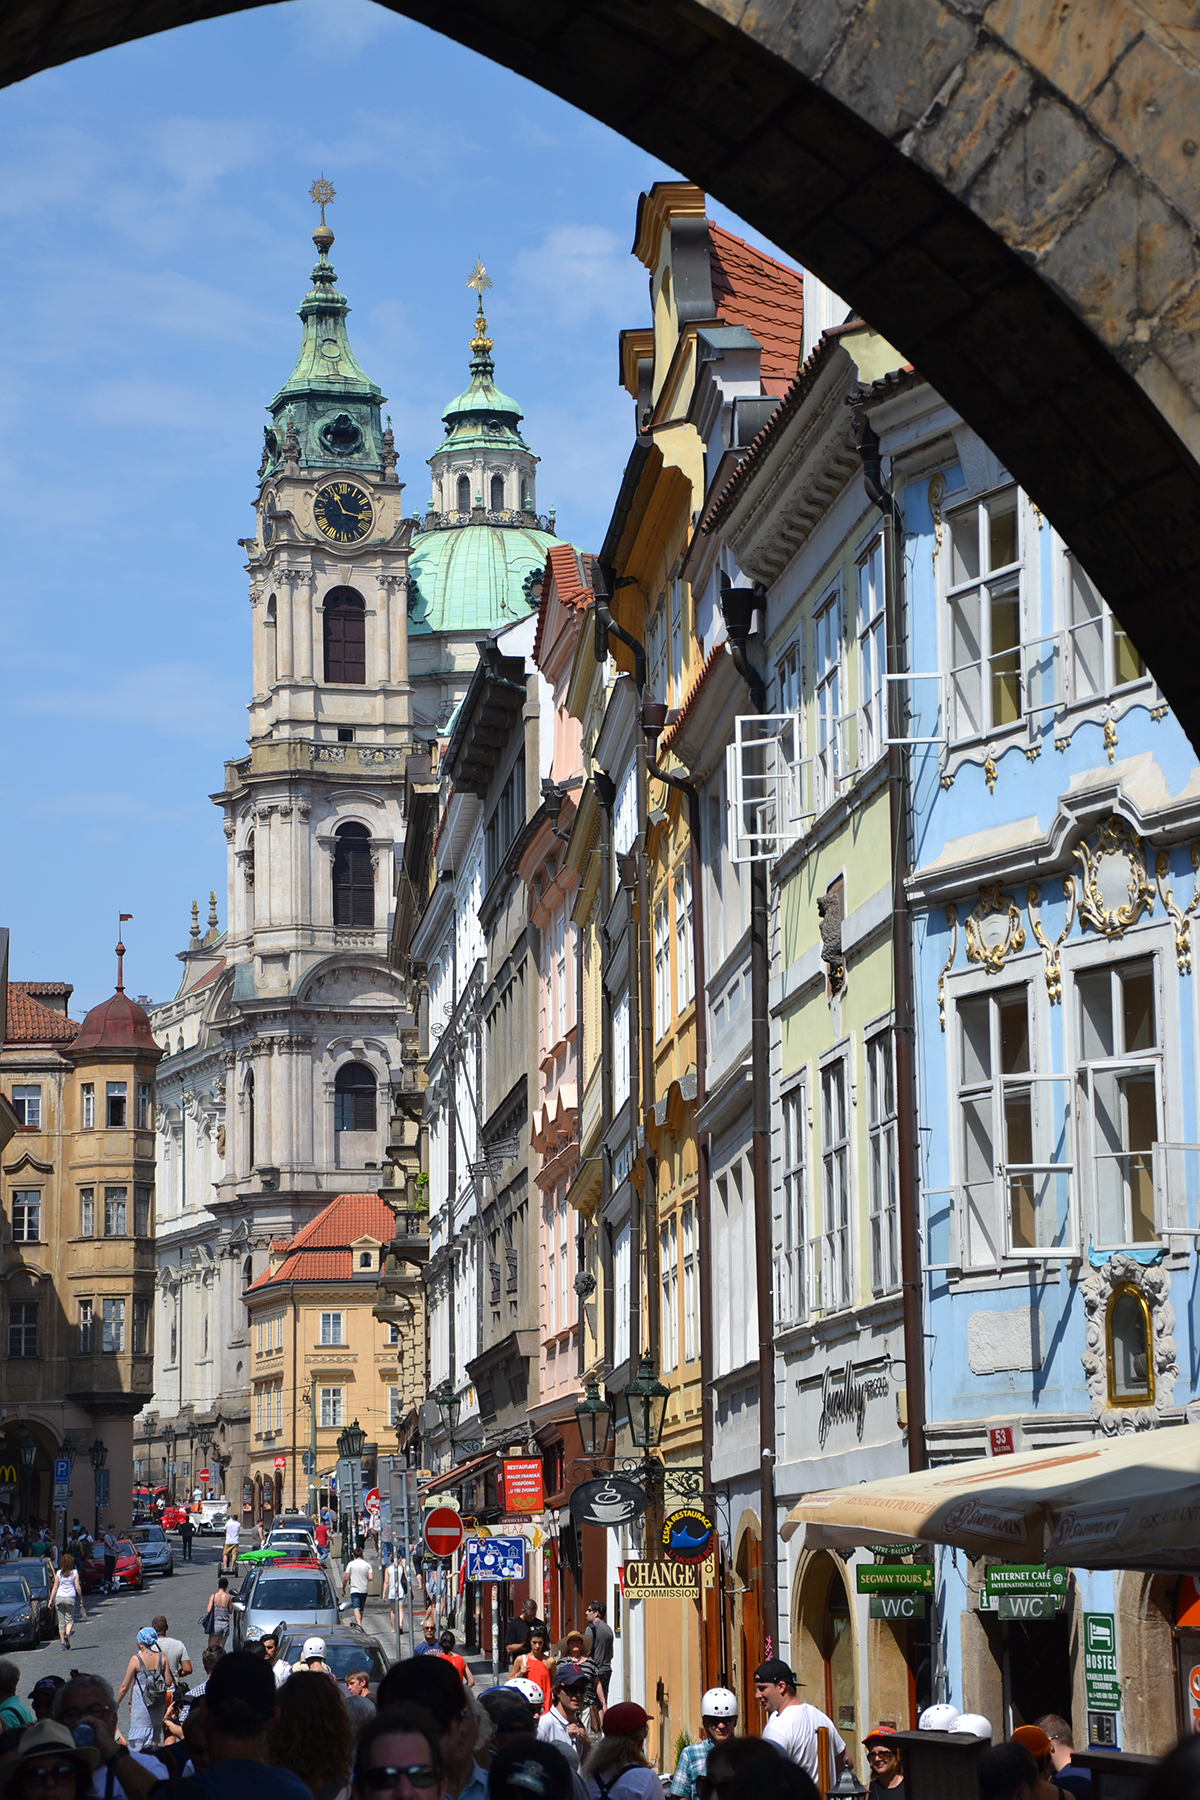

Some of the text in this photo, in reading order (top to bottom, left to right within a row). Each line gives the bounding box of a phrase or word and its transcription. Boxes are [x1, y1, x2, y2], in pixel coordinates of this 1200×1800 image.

[995, 1429, 1006, 1445] 53
[58, 1462, 66, 1476] P
[896, 1500, 915, 1511] POD
[670, 1510, 712, 1529] RESTAURACE
[668, 1549, 676, 1557] U
[675, 1553, 704, 1565] MODRÉ
[626, 1562, 695, 1587] CHANGE
[860, 1574, 922, 1584] SEGWAY TOURS
[991, 1571, 1029, 1581] INTERNET
[1031, 1569, 1051, 1580] CAFÉ
[637, 1589, 698, 1598] COMMISSION
[881, 1599, 914, 1617] WC
[1010, 1599, 1044, 1617] WC
[1086, 1654, 1117, 1669] HOSTEL
